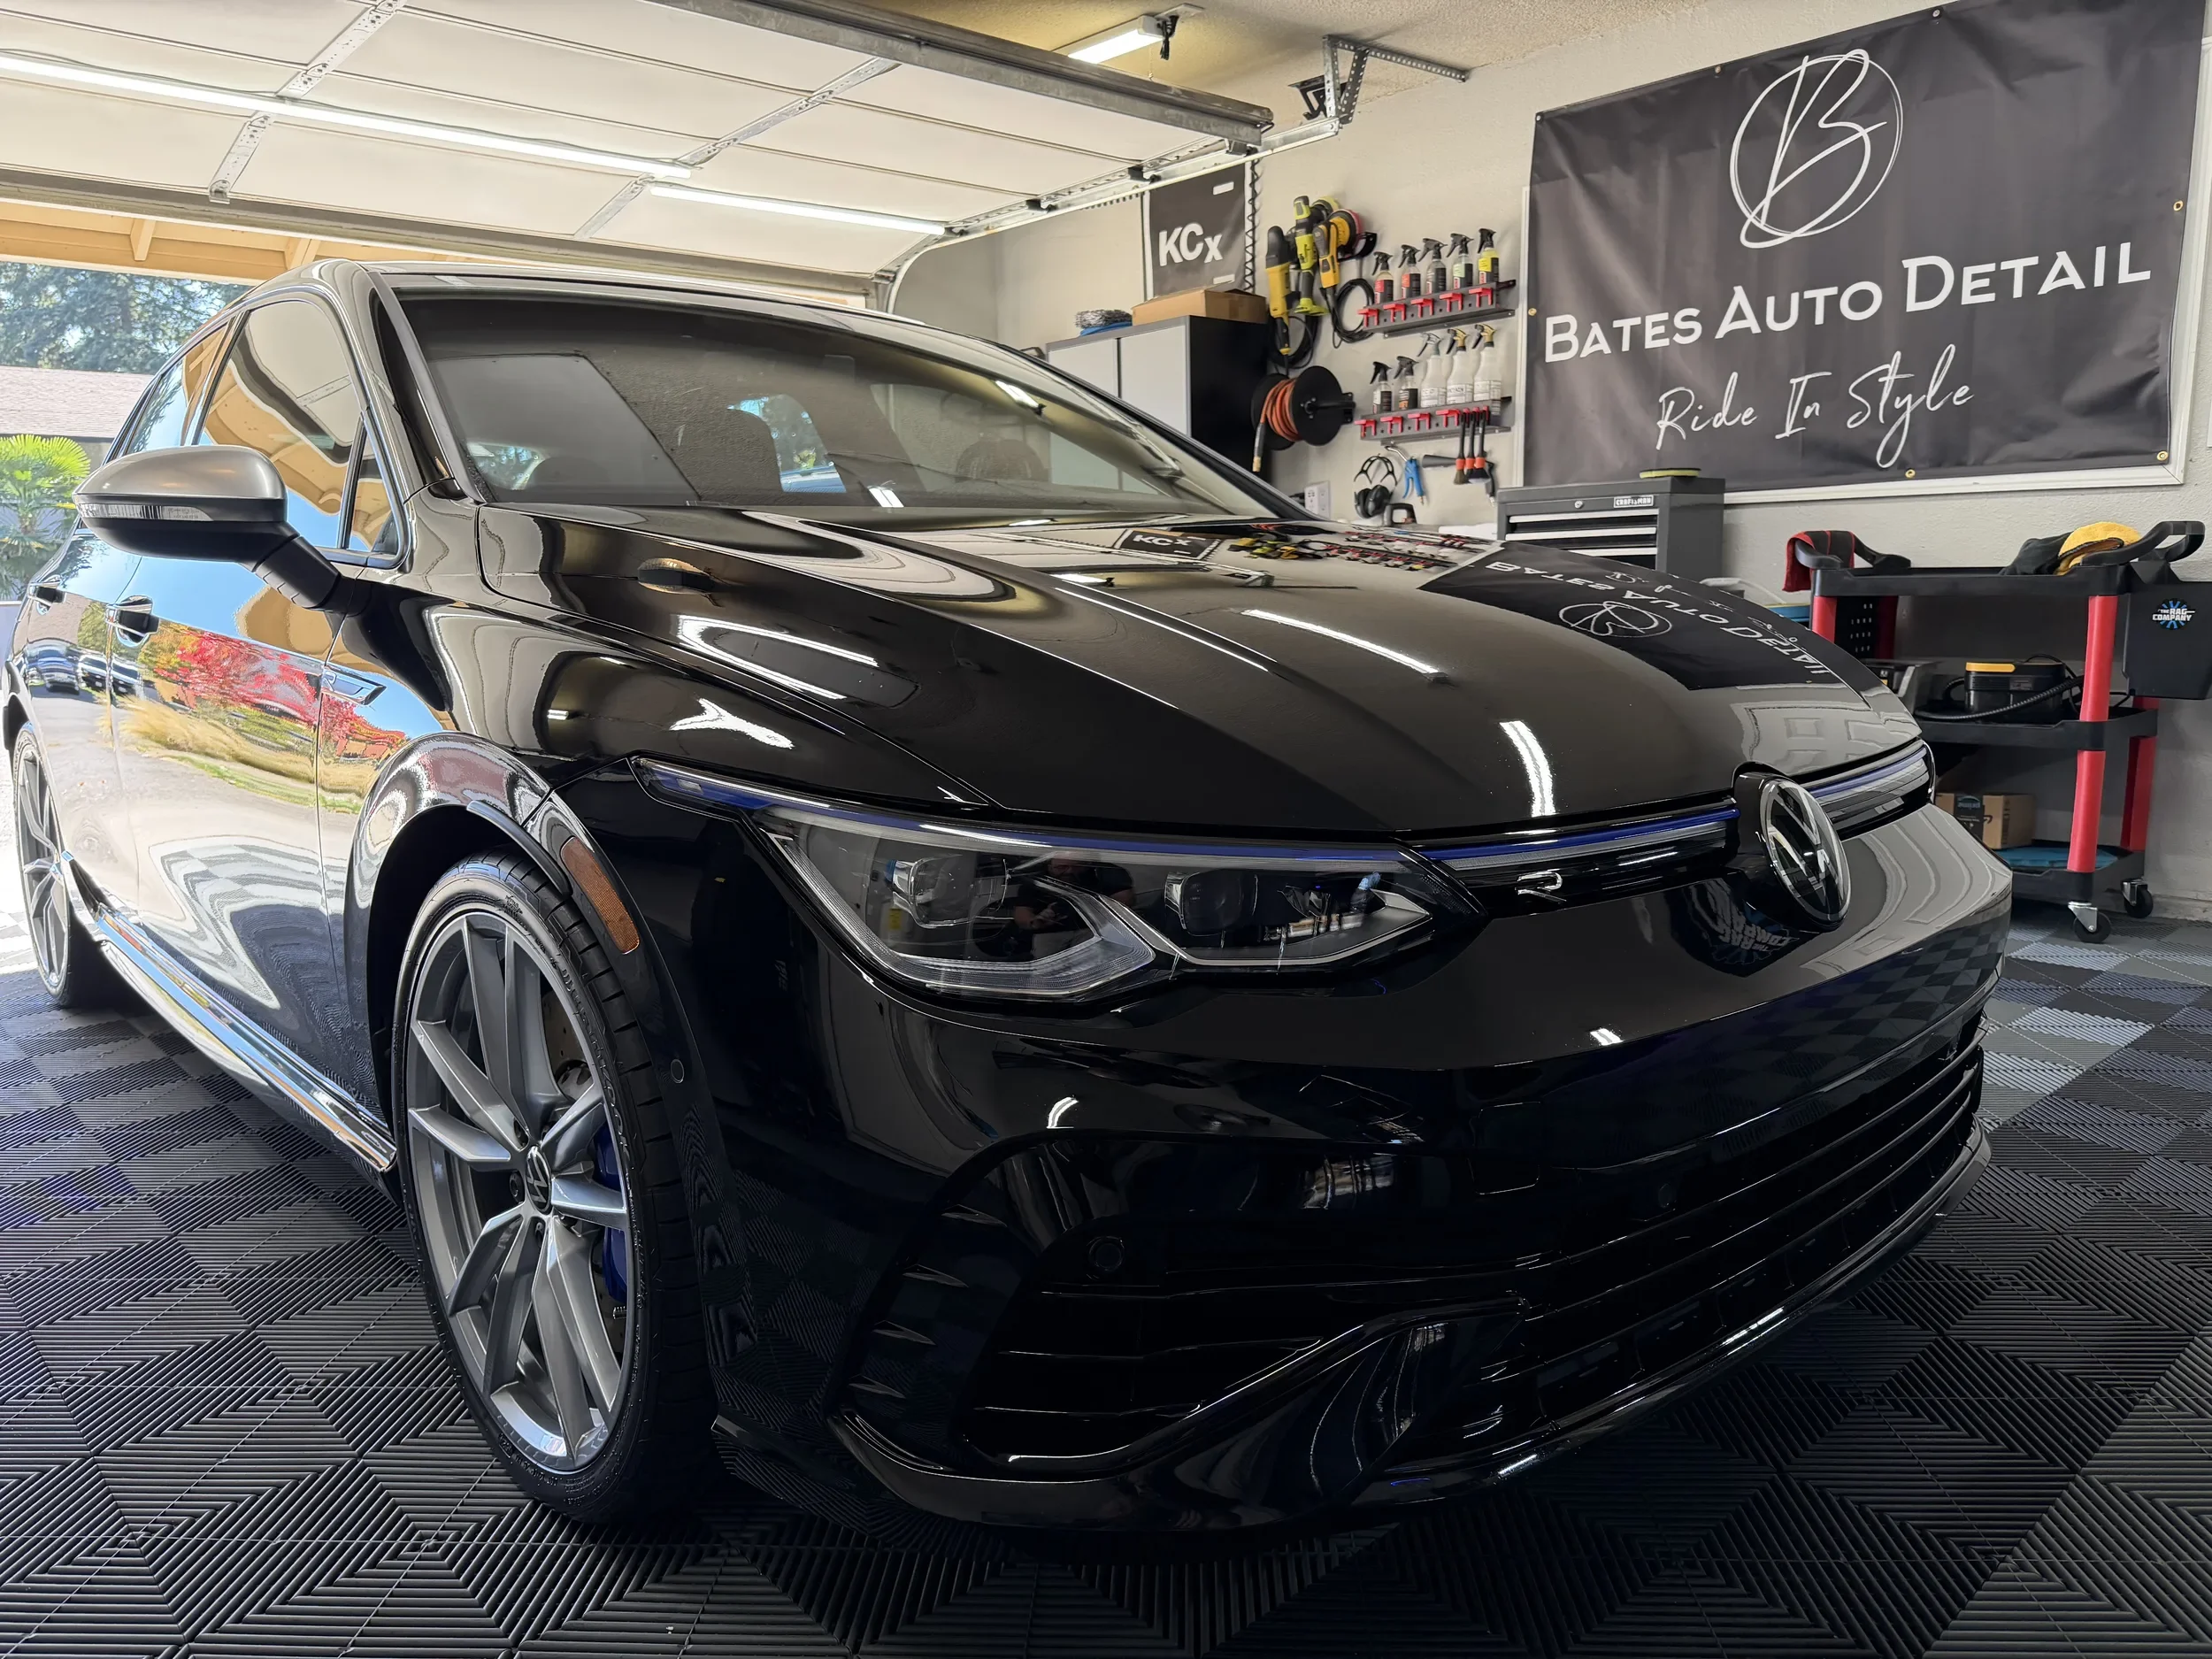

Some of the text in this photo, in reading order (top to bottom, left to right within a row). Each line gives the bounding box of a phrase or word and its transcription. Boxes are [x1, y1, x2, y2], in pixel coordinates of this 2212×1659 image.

[1158, 222, 1224, 267] KCx
[1655, 343, 1974, 468] Ride In Style
